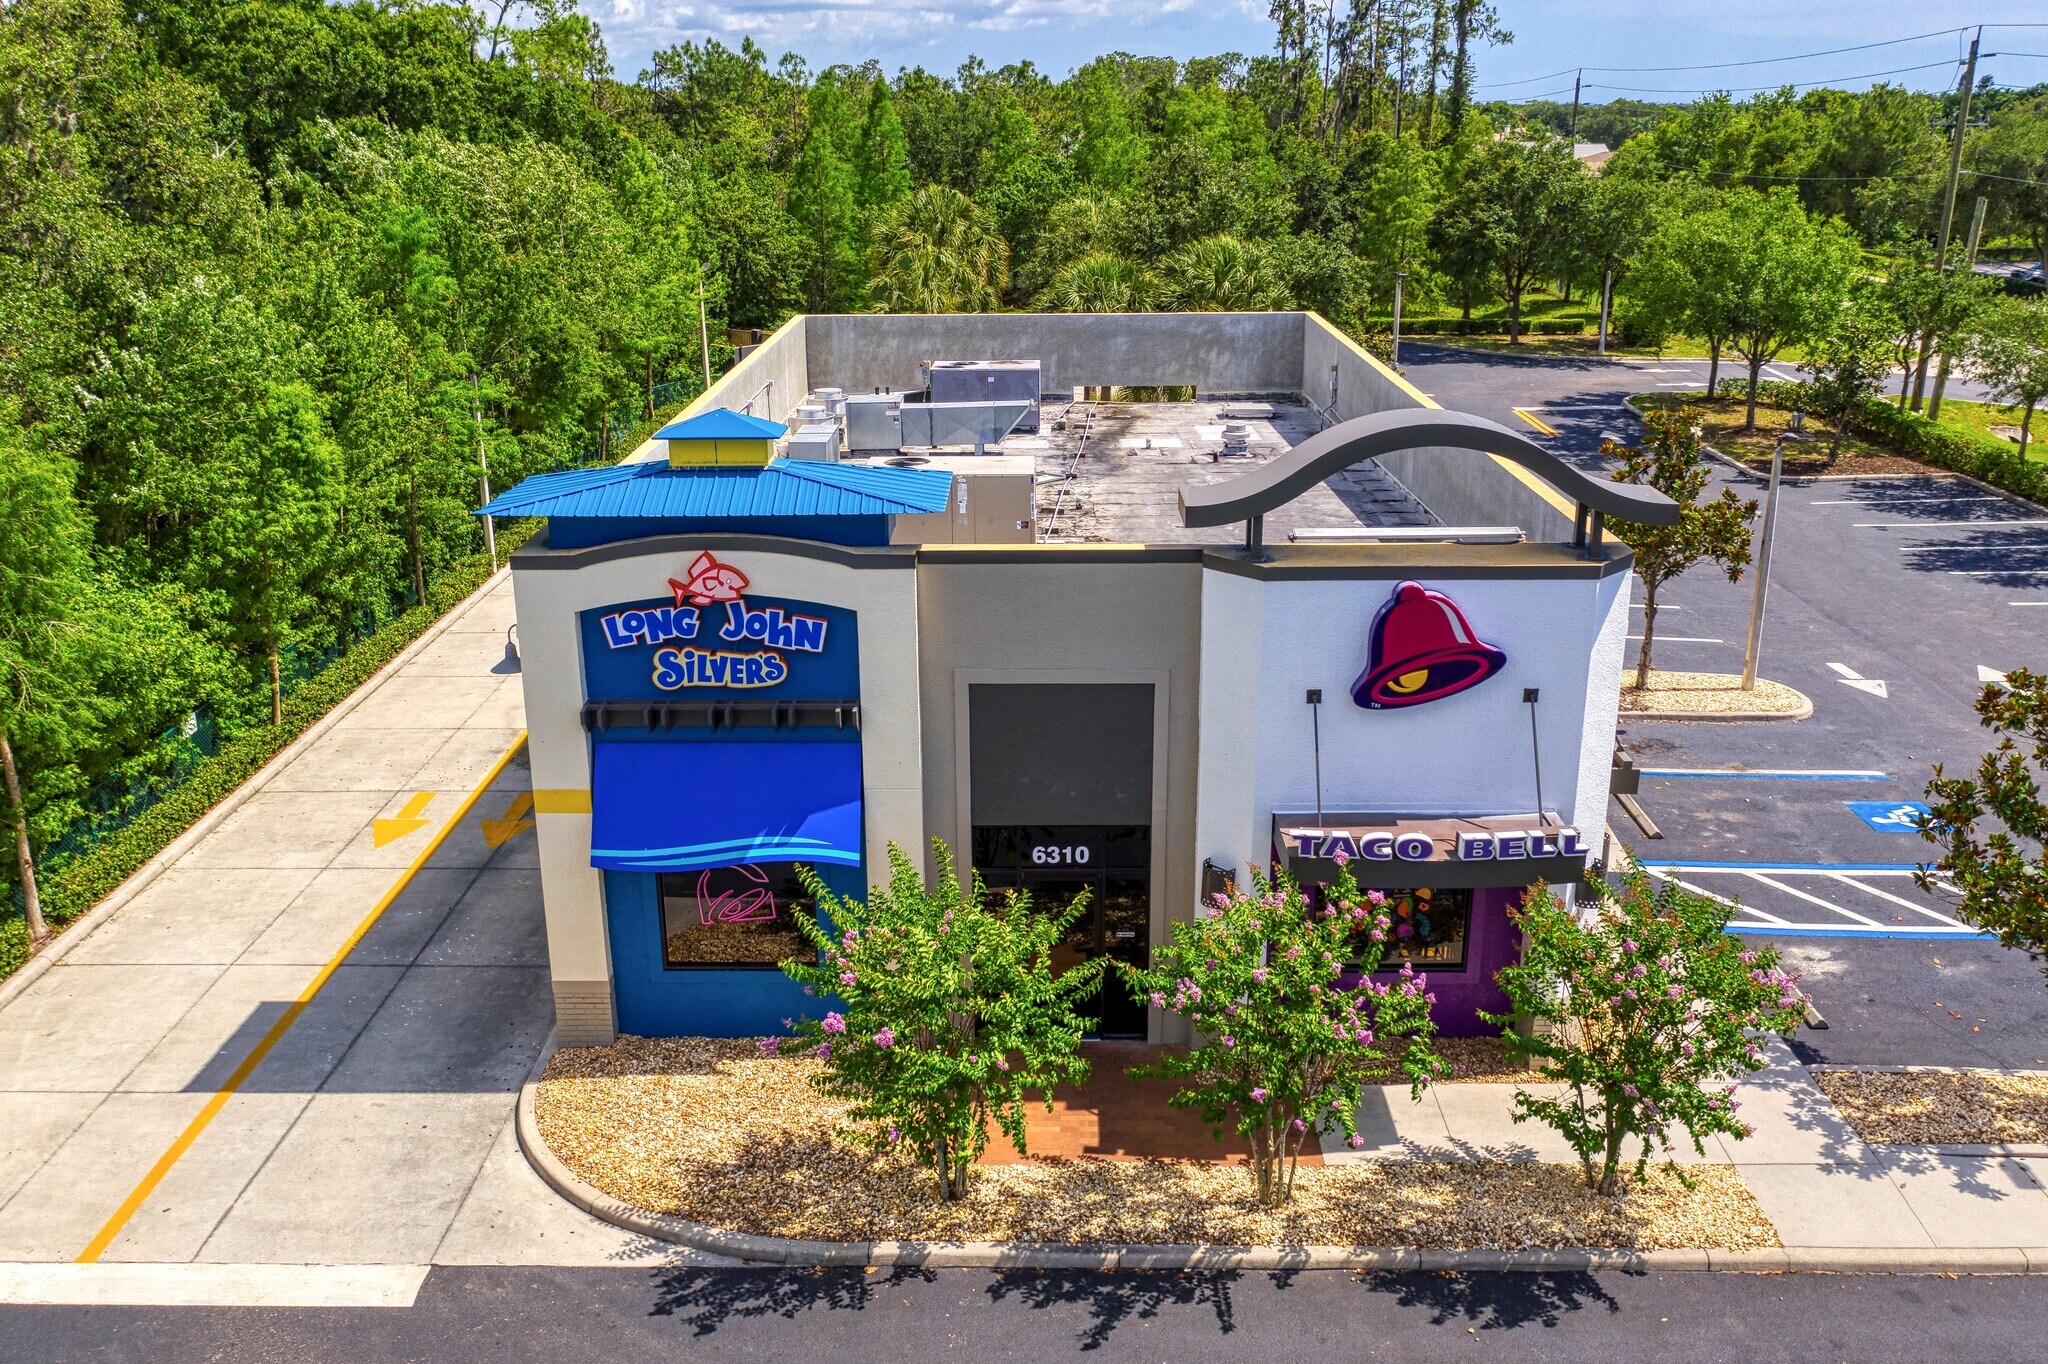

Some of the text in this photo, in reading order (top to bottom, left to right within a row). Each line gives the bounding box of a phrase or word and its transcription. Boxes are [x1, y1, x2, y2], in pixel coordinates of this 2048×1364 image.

[1032, 846, 1090, 864] 6310
[1289, 829, 1590, 861] TACO BELL
